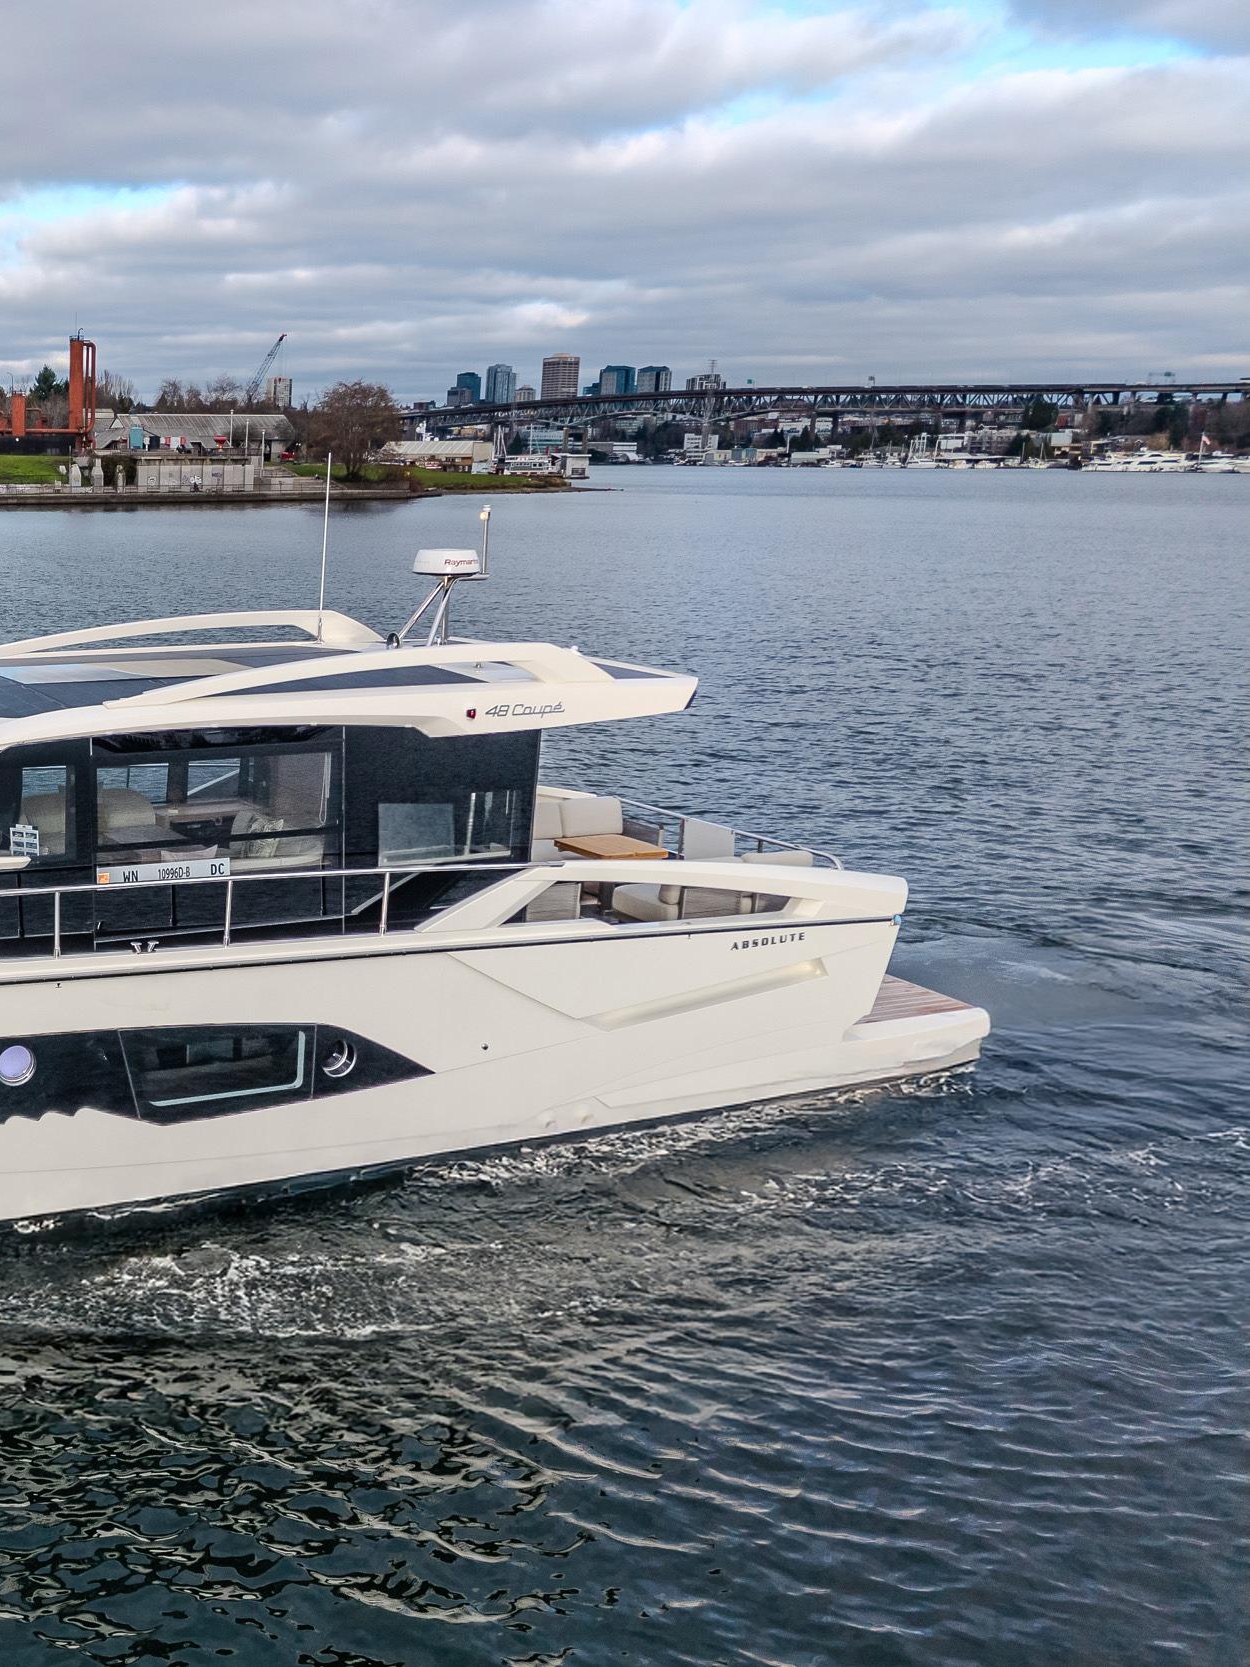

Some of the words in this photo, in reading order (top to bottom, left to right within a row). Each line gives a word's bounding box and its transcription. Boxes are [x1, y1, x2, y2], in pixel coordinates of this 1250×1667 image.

[485, 704, 510, 717] 48
[511, 701, 565, 719] Coupé
[123, 870, 139, 883] WN
[210, 863, 225, 876] DC
[730, 932, 806, 951] ABSOLUTE
